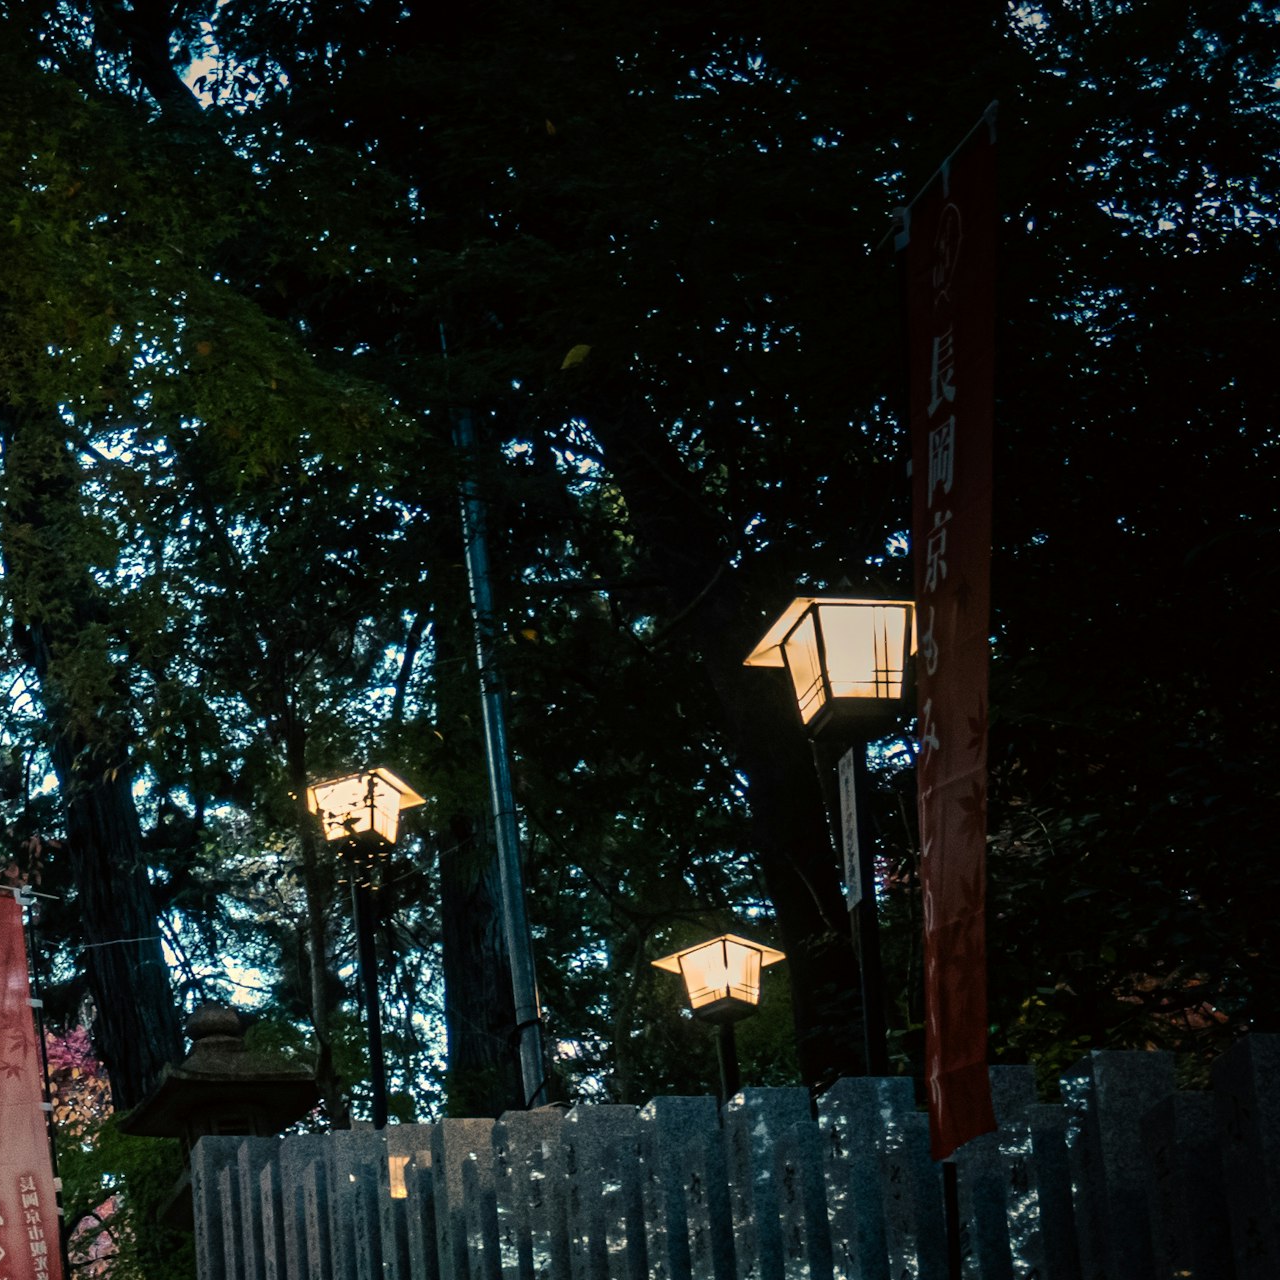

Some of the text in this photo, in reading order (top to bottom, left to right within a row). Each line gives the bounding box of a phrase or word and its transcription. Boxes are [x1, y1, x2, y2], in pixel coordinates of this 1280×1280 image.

[920, 321, 958, 1132] 長岡京もみじめり
